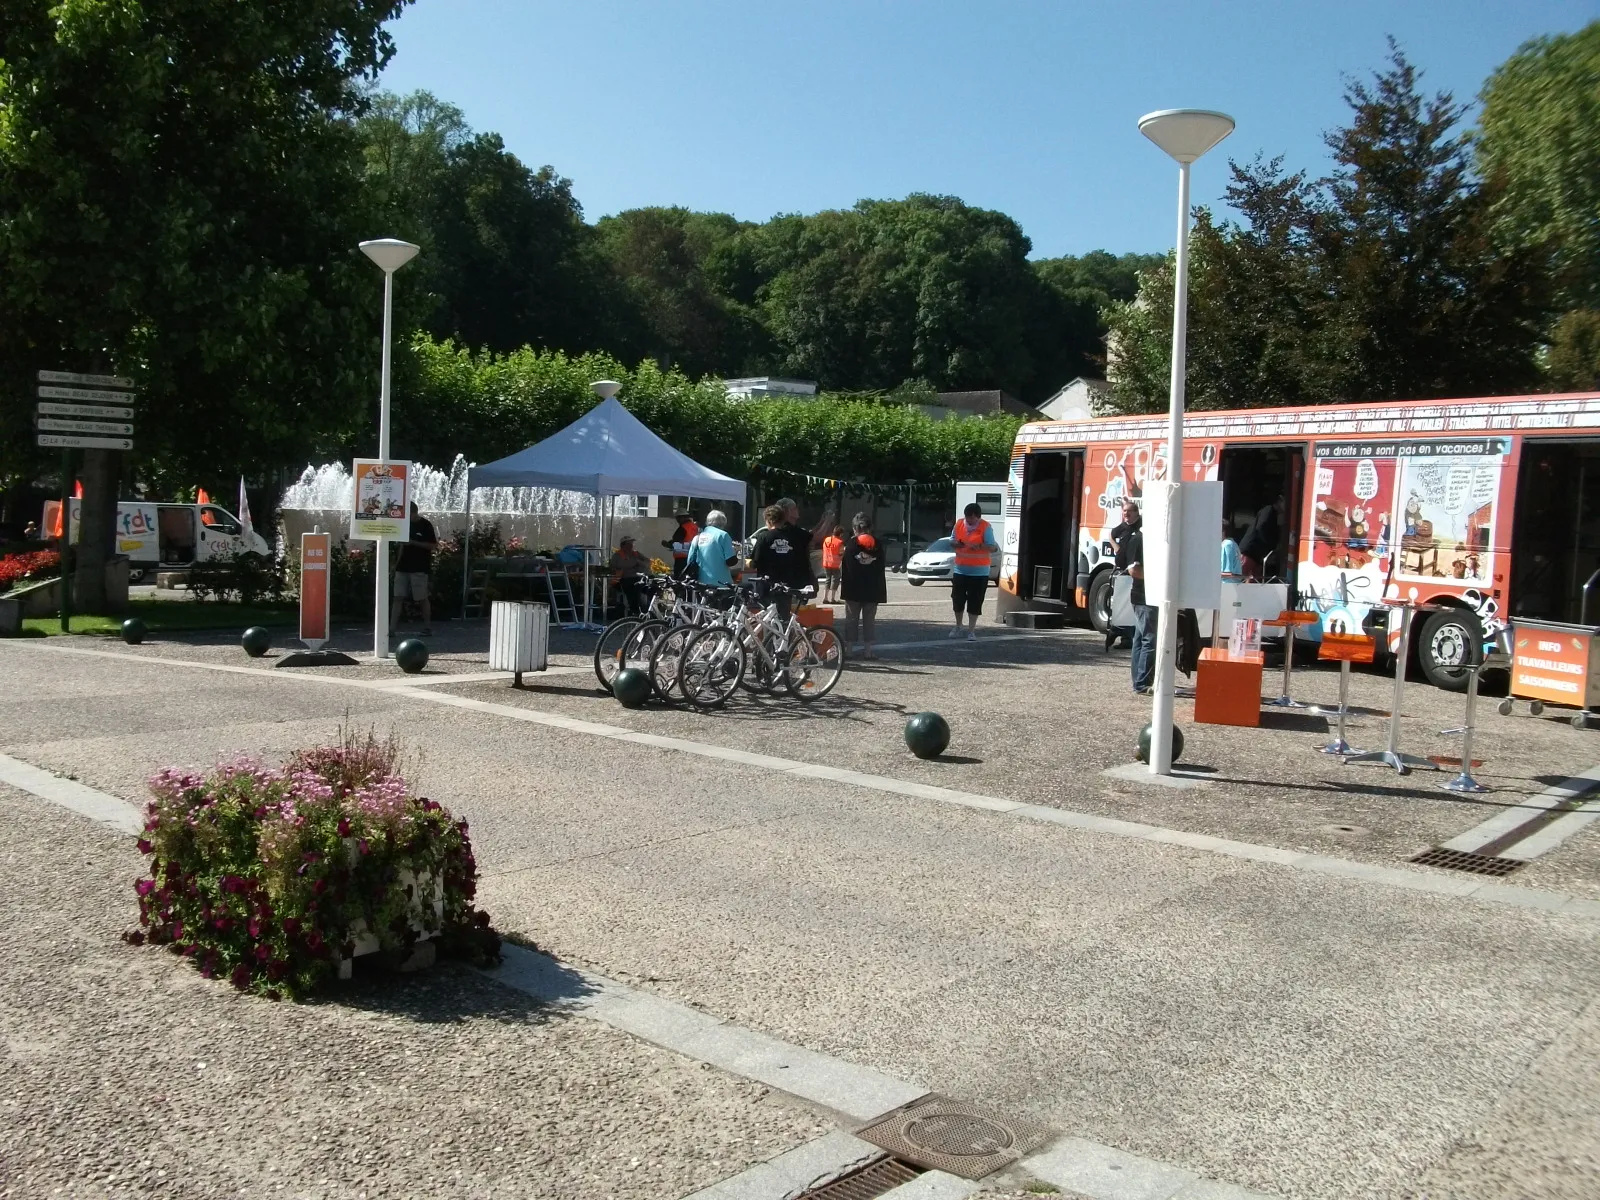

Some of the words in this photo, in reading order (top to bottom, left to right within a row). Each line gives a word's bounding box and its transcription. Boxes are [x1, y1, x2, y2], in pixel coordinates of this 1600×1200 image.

[1316, 448, 1330, 456] vos
[1333, 446, 1357, 456] droits
[1360, 447, 1372, 455] ne
[1375, 445, 1395, 455] sont
[1398, 445, 1416, 456] pas
[1418, 445, 1431, 454] en
[1435, 444, 1484, 454] vacances
[1538, 640, 1562, 652] INFO
[1517, 655, 1584, 675] TRAVAILLEURS
